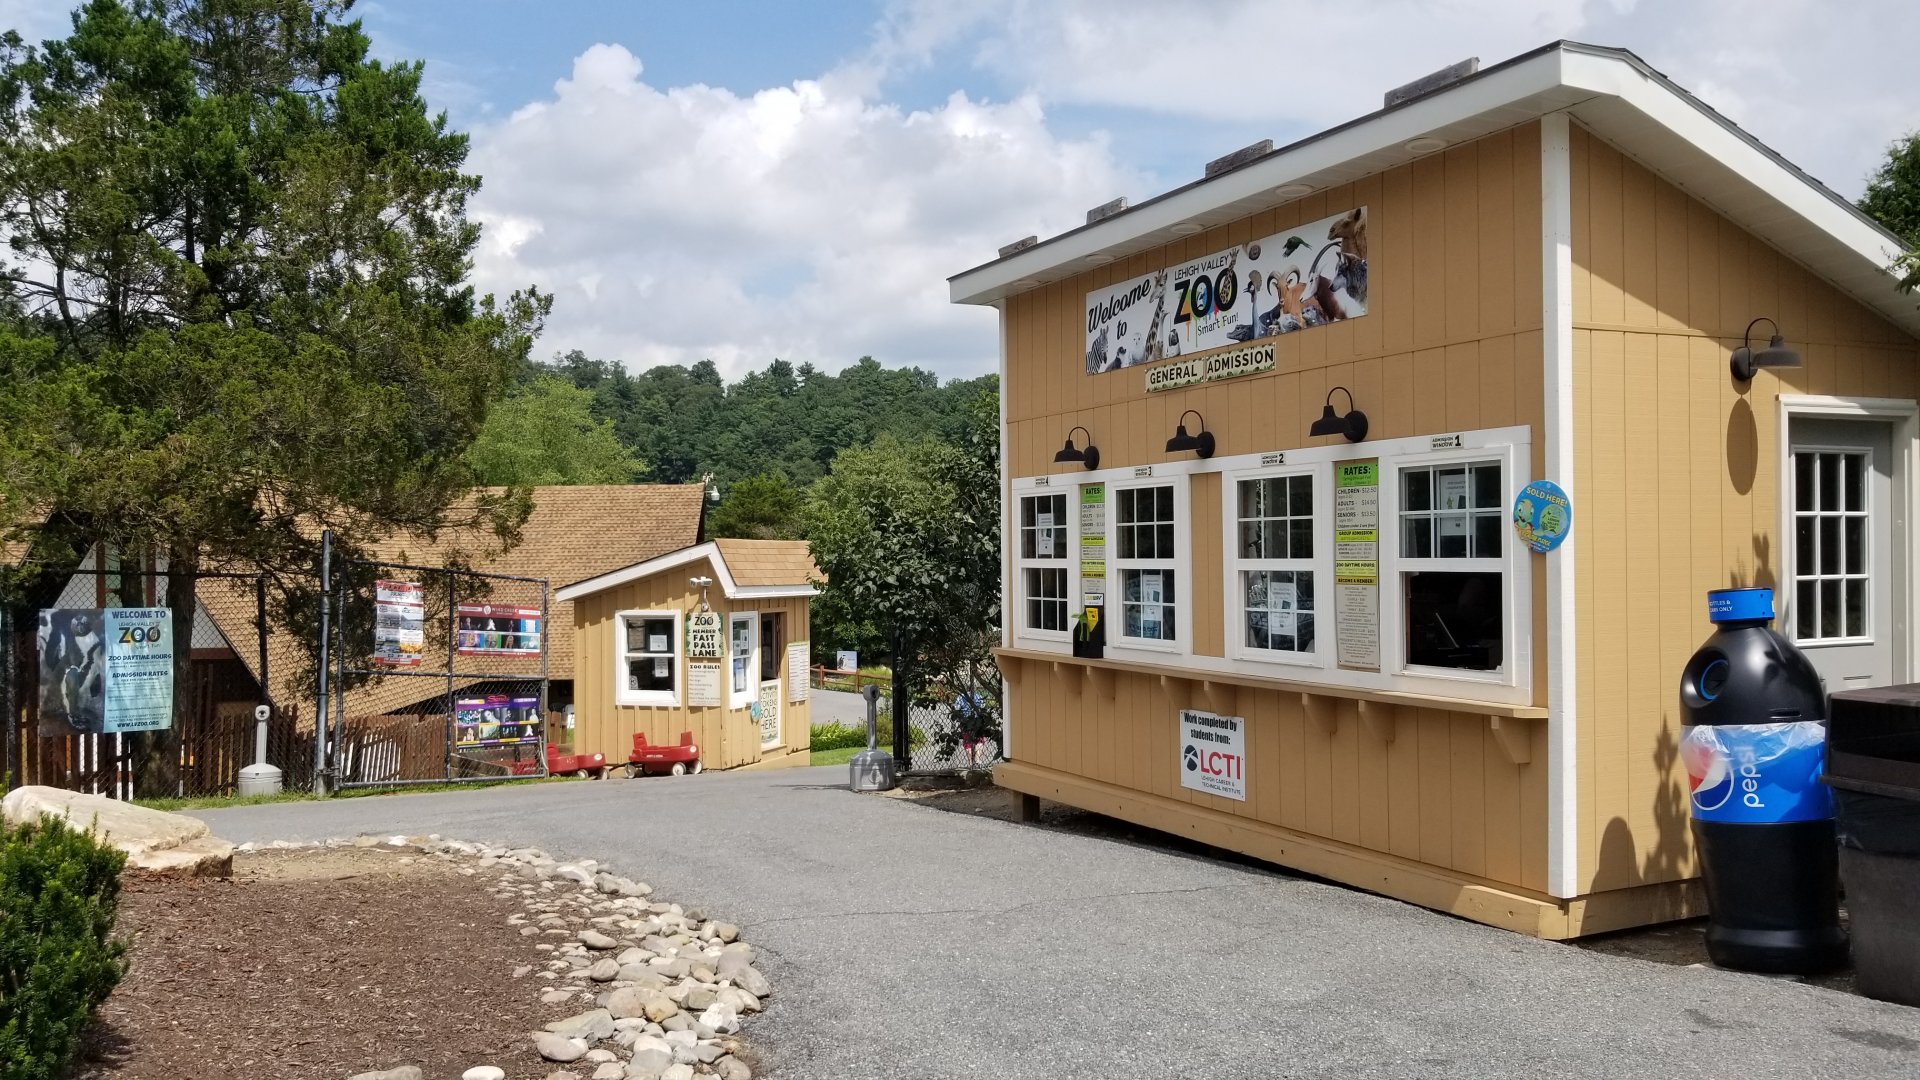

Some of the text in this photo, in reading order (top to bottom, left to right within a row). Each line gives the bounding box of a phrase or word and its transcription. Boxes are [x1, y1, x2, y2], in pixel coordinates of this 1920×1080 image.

[1174, 256, 1230, 280] LEHIGH VALLEY
[1174, 268, 1238, 324] ZOO
[1088, 278, 1152, 334] Welcome
[1117, 320, 1128, 340] to
[1198, 312, 1239, 336] Smart Fun!
[1150, 348, 1274, 384] GENERAL ADMISSION
[1455, 435, 1461, 446] 1
[1279, 454, 1284, 463] 2
[1148, 466, 1152, 476] 3
[1344, 466, 1370, 475] RATES:
[1046, 476, 1049, 485] 4
[1526, 487, 1567, 506] SOLD HERE!
[695, 617, 713, 625] ZOO
[119, 627, 160, 643] ZOO
[760, 707, 776, 719] SOLD
[761, 718, 776, 730] HERE
[1184, 712, 1237, 732] Work completed by
[1191, 729, 1230, 745] students from:
[1200, 749, 1240, 780] LCTI
[1202, 782, 1221, 790] TECHNICAL
